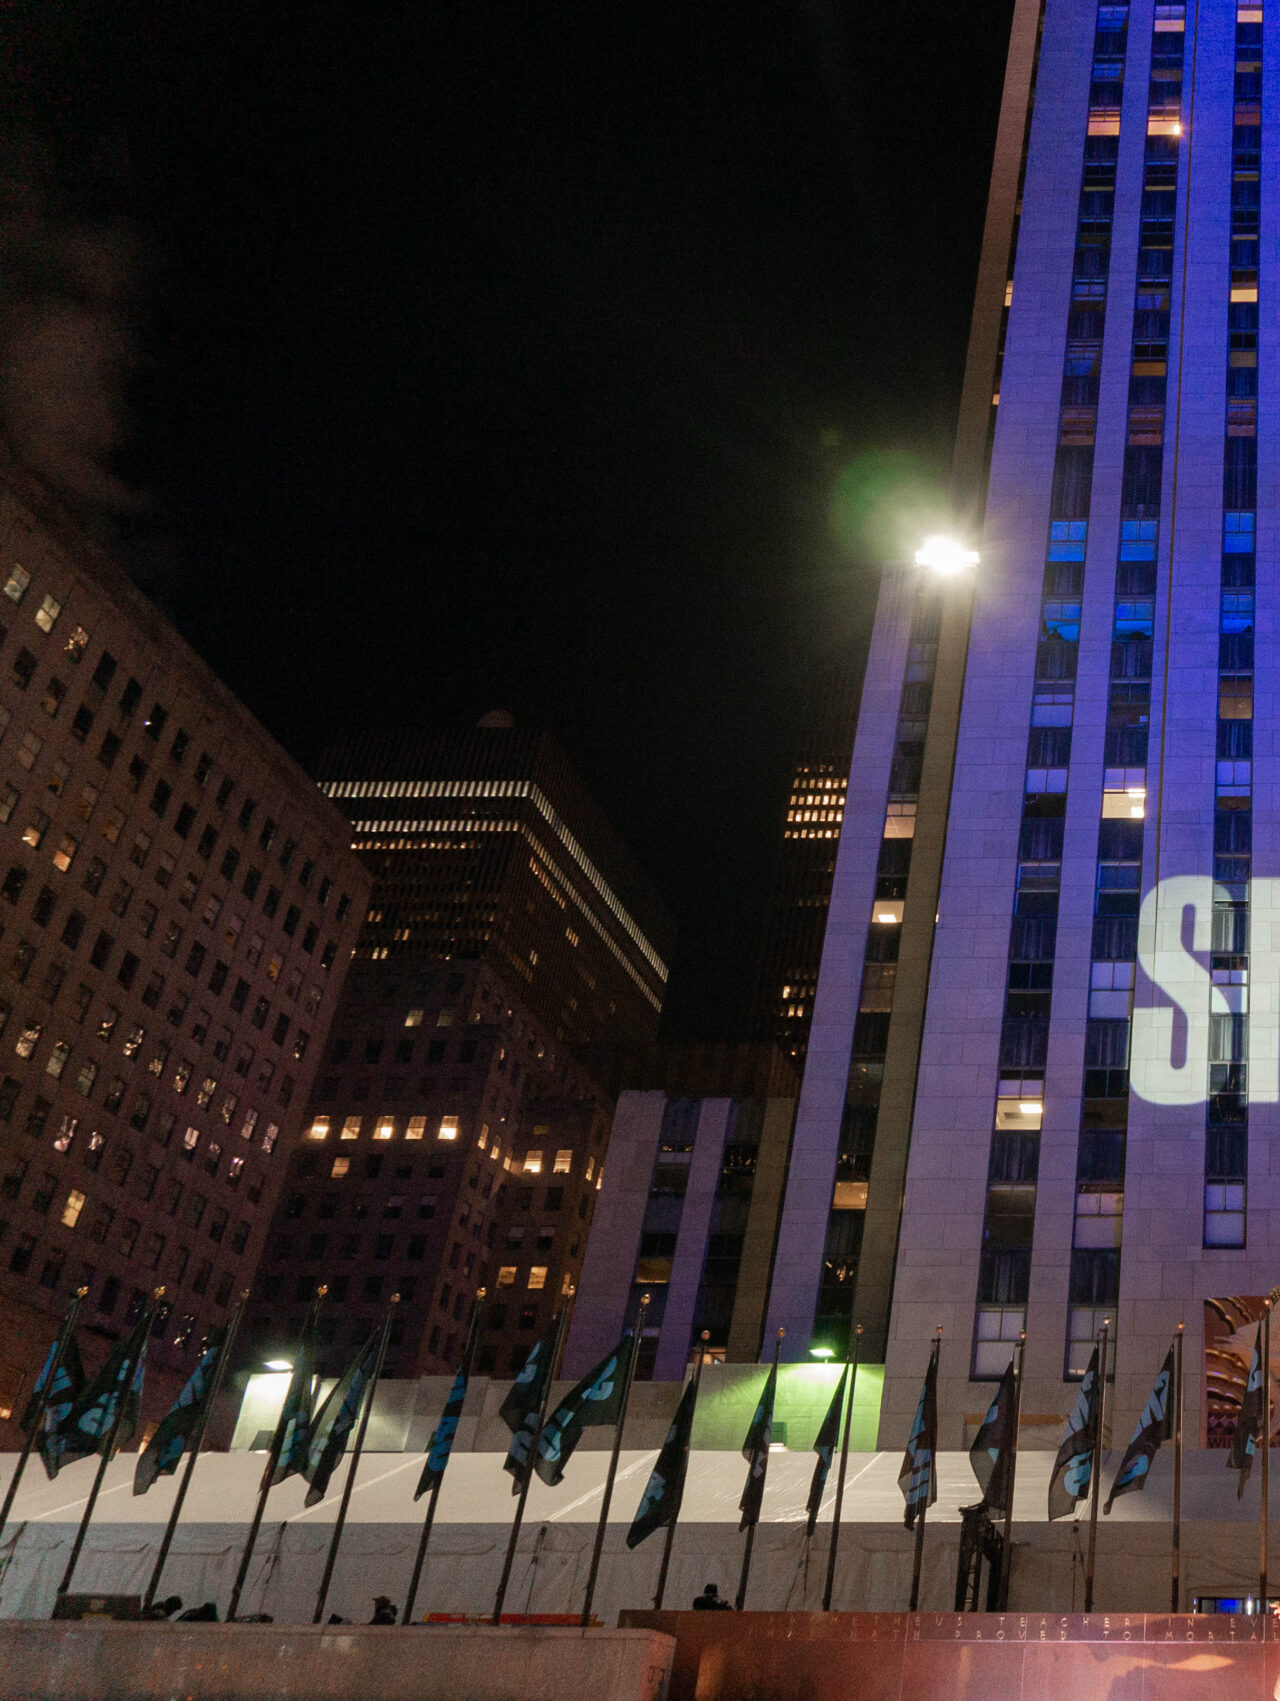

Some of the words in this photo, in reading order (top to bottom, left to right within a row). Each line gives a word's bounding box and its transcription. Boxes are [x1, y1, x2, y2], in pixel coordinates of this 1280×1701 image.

[999, 1617, 1132, 1628] TEACHER
[1167, 1617, 1195, 1628] IN
[1103, 1630, 1132, 1641] TO
[1164, 1630, 1280, 1642] MORTAL
